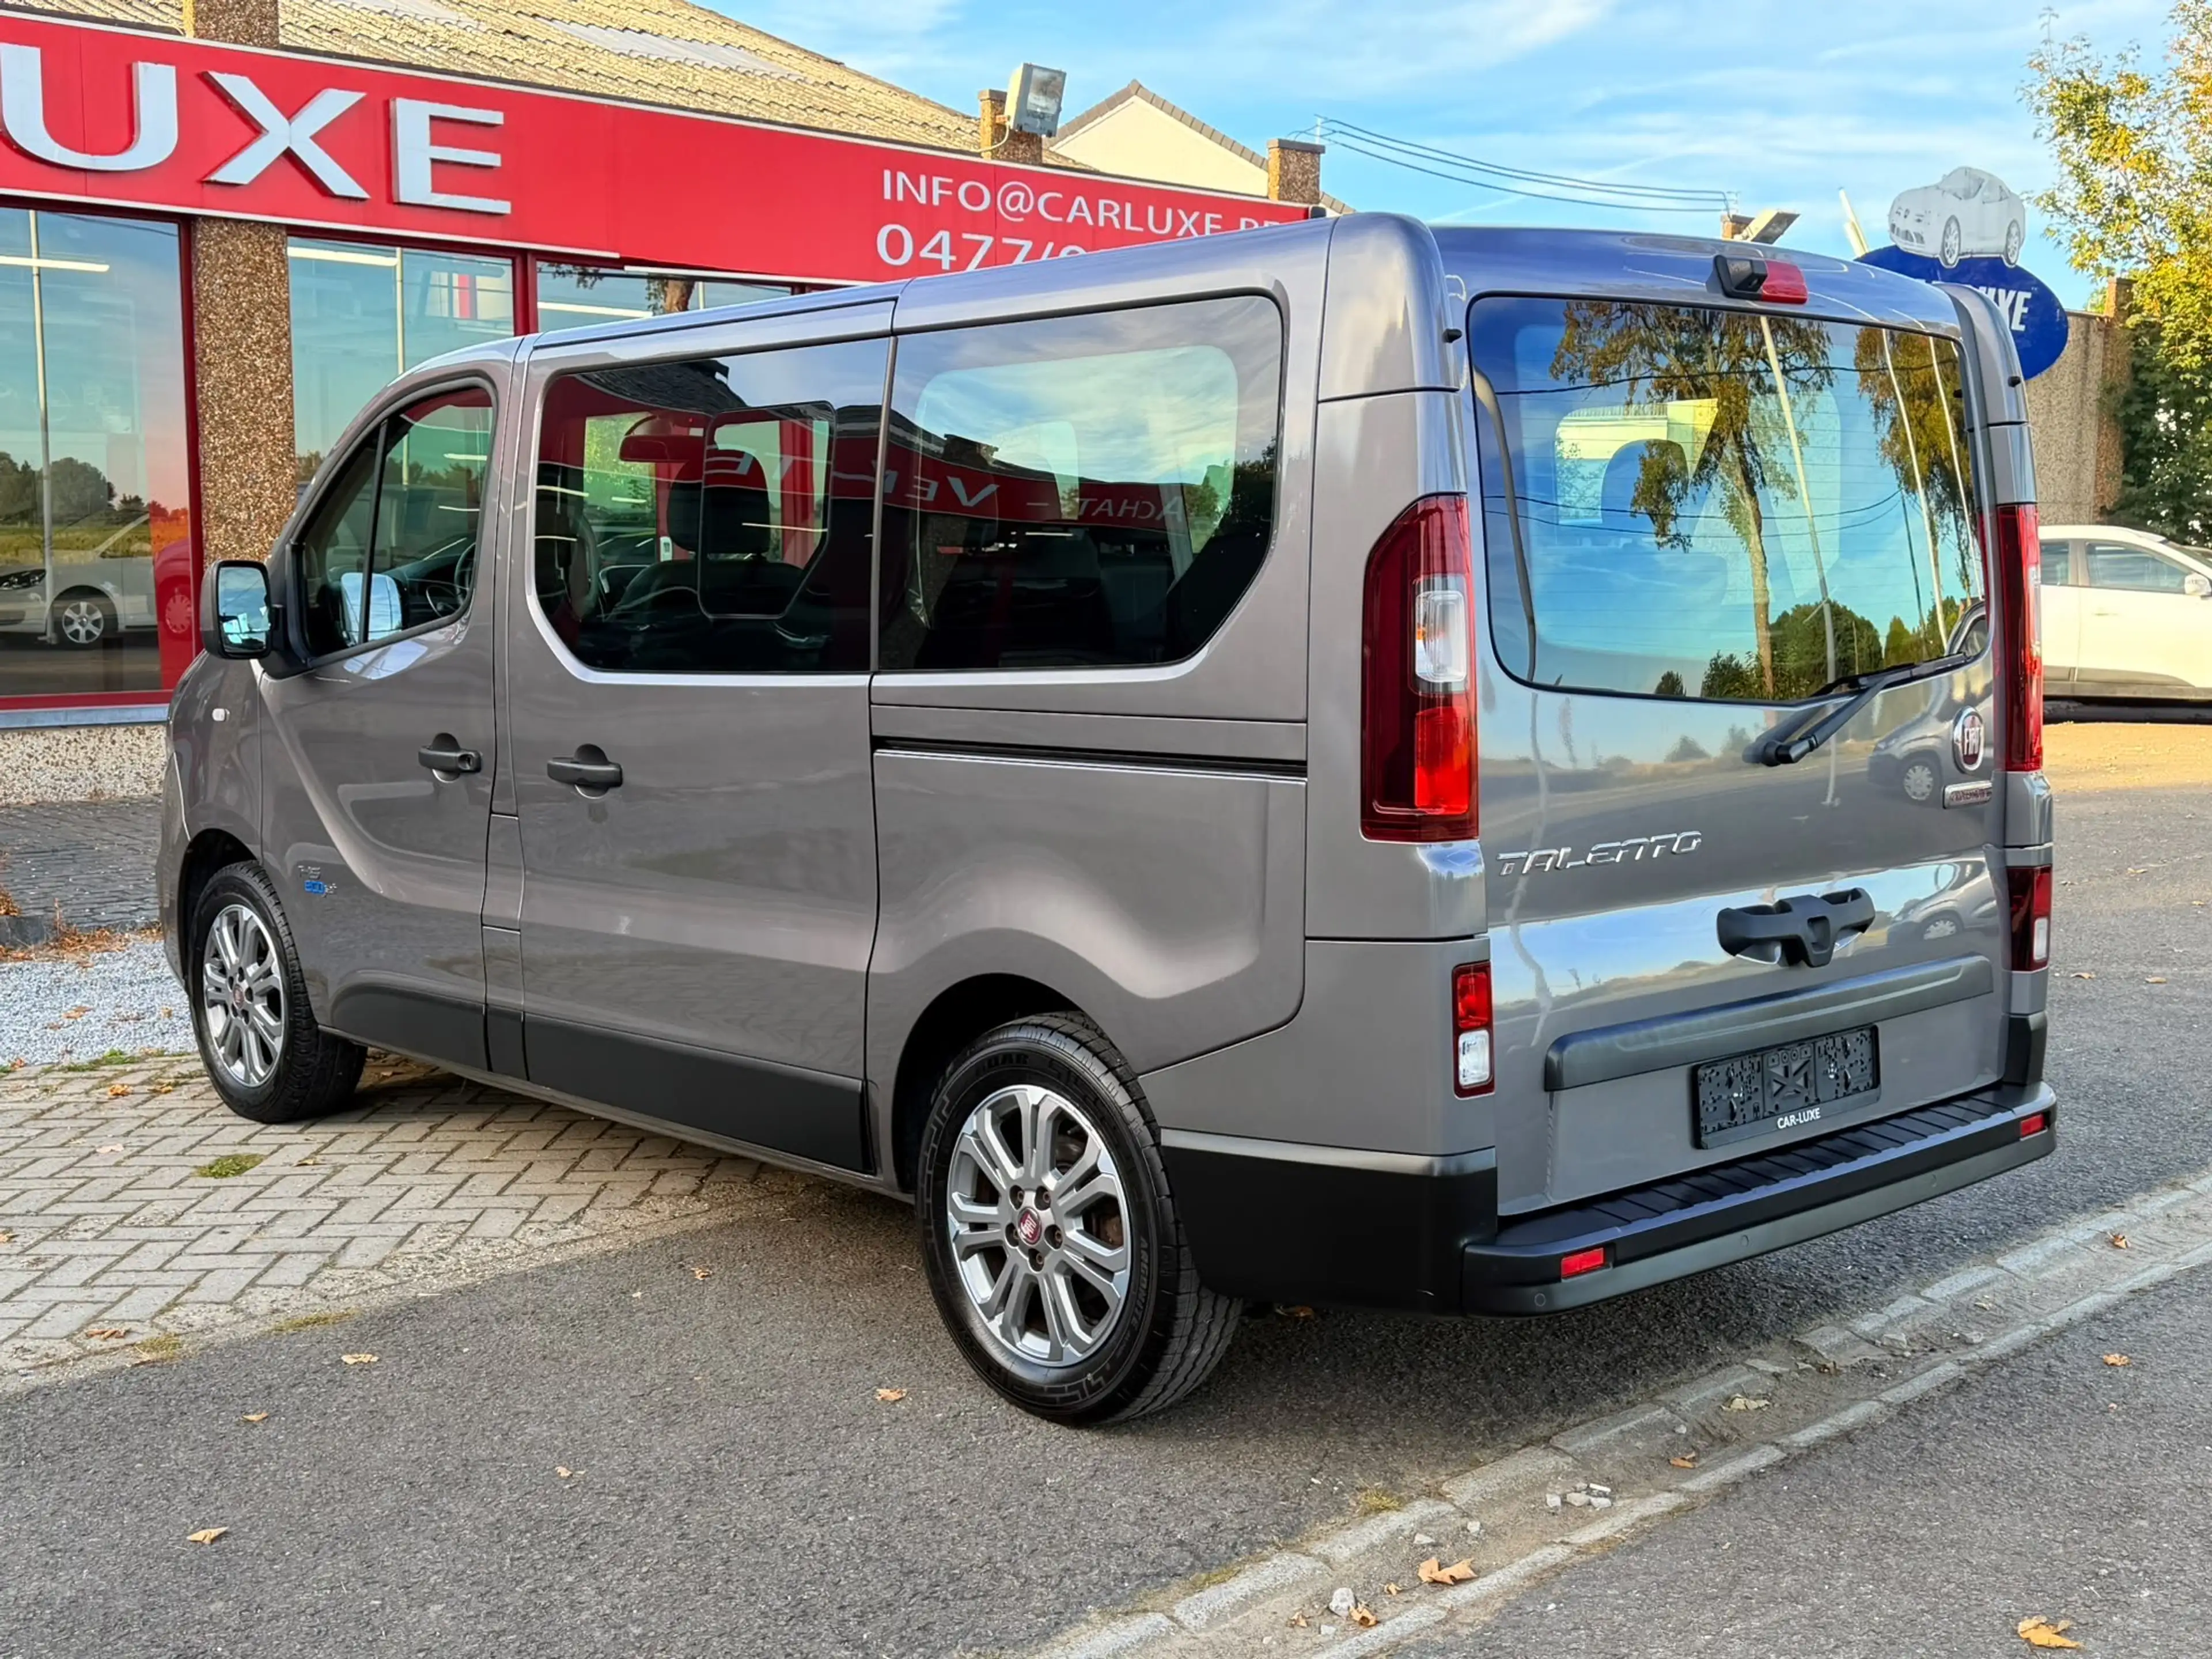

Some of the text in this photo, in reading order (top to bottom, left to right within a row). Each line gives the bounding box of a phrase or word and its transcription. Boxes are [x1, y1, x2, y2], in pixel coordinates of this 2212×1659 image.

[0, 43, 512, 215] UXE
[1496, 830, 1702, 876] TALENTO
[1776, 1107, 1821, 1130] CAR-LUXE
